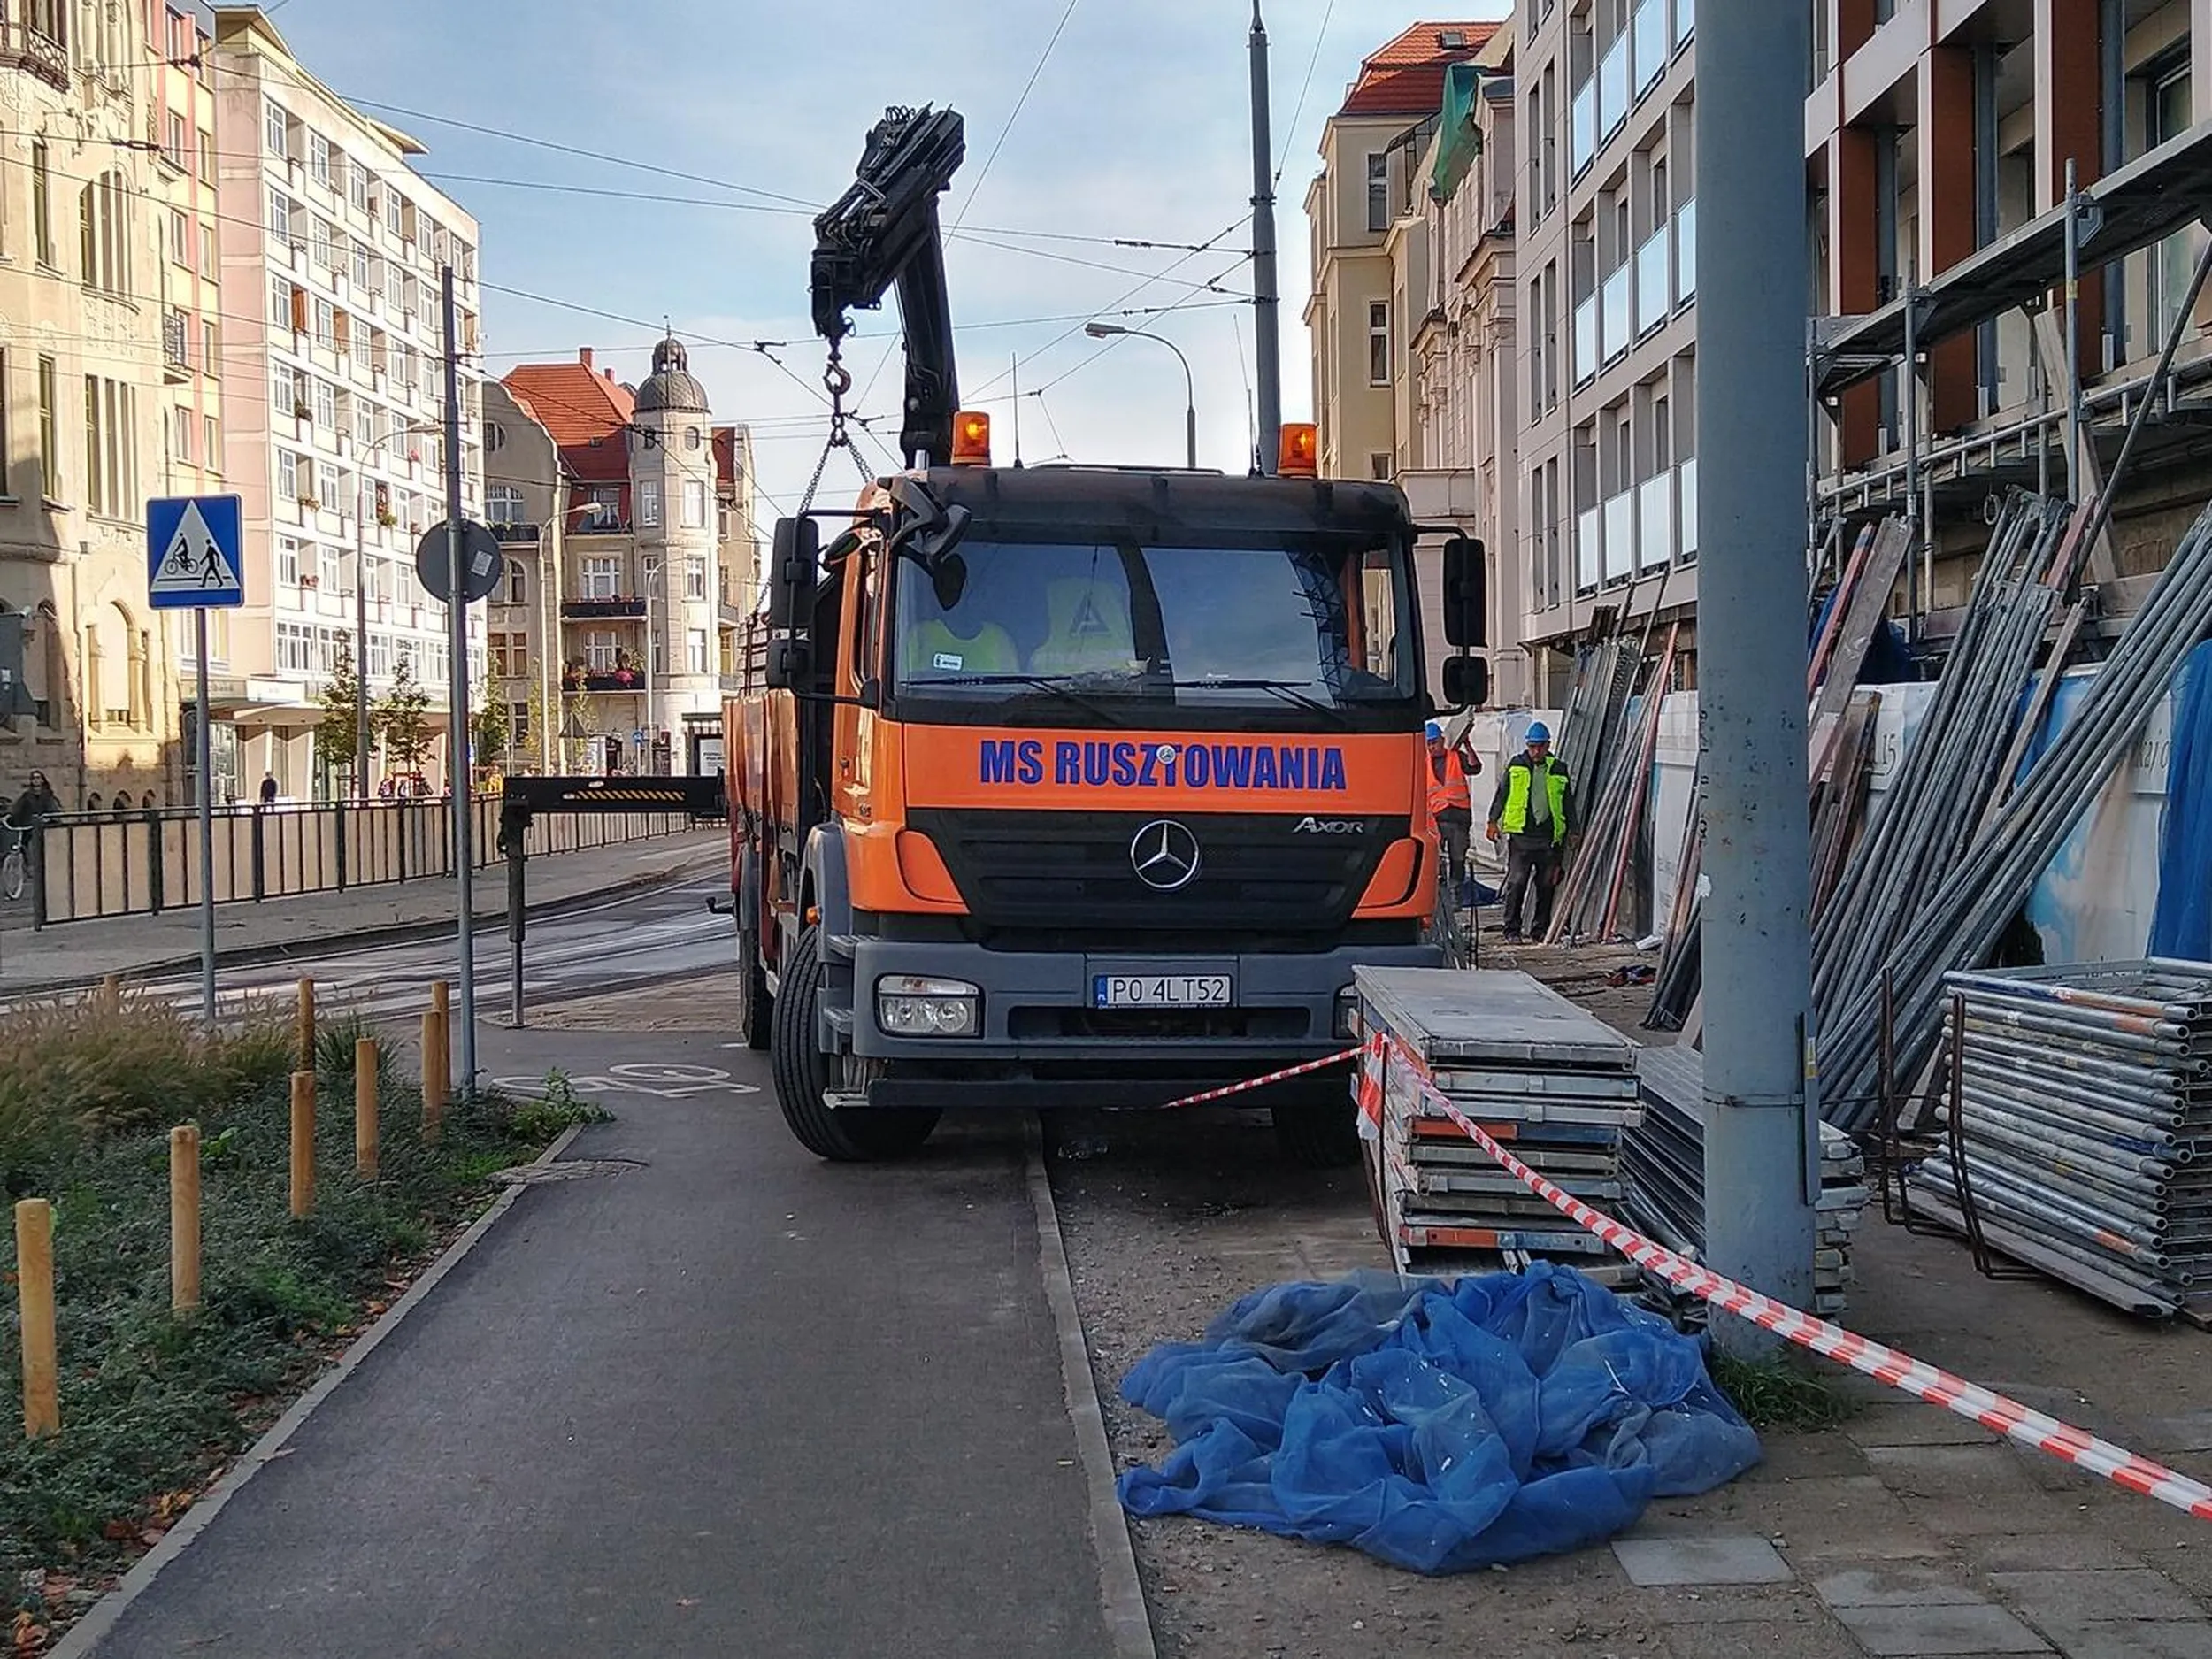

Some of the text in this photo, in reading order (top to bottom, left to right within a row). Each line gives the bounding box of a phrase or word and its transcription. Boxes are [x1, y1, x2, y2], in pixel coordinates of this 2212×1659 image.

[980, 741, 1347, 790] MS RUSZTOWANIA
[1113, 979, 1225, 1002] PO 4LT52
